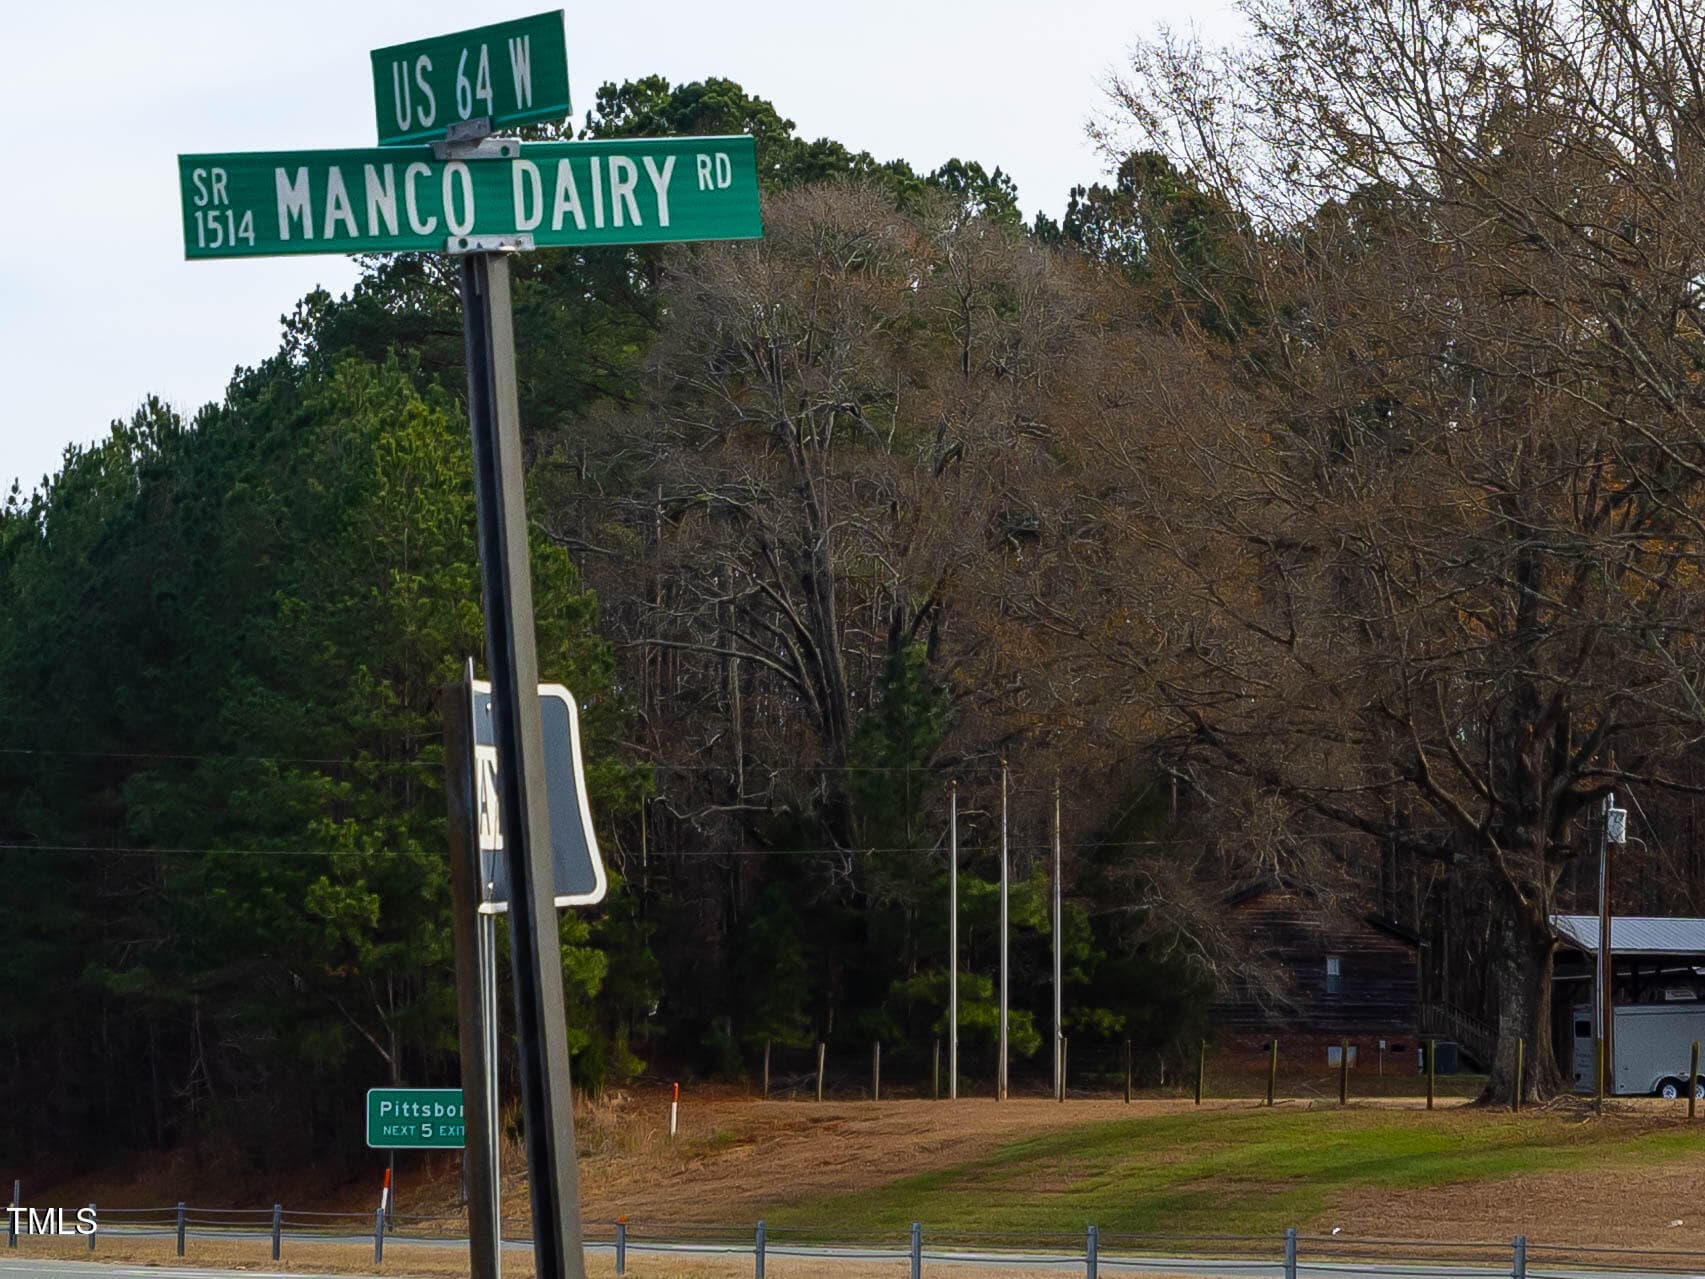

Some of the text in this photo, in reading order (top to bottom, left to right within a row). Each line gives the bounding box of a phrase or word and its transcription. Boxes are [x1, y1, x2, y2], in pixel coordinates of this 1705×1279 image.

[392, 35, 532, 132] US 64 W
[193, 167, 229, 207] SR
[274, 152, 732, 240] MANCO DAIRY RD
[195, 209, 255, 248] 1514
[380, 1101, 464, 1117] Pittsbor
[383, 1123, 465, 1138] NEXT 5 EXIT
